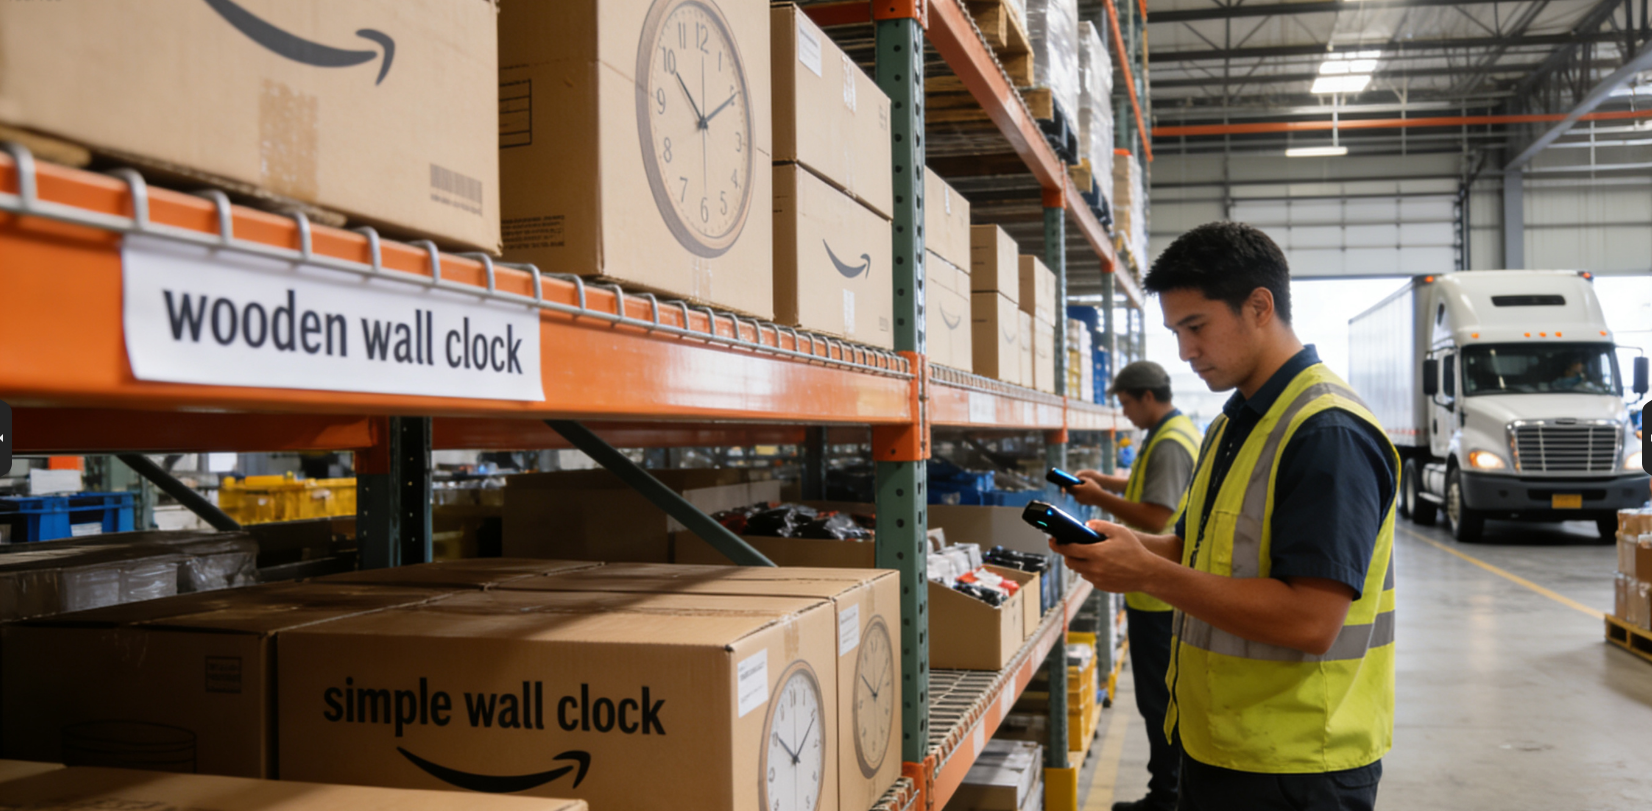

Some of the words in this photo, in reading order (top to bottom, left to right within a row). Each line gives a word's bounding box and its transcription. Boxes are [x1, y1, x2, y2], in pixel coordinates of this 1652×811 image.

[695, 21, 709, 55] 12
[661, 46, 676, 76] 10
[656, 87, 666, 115] 9
[663, 136, 672, 163] 8
[679, 176, 688, 203] 7
[720, 190, 728, 216] 5
[700, 196, 709, 224] 6
[163, 289, 348, 357] wooden
[361, 309, 434, 366] wall
[445, 316, 524, 375] clock
[323, 676, 452, 738] simple
[463, 680, 545, 730] wall
[557, 682, 666, 736] clock
